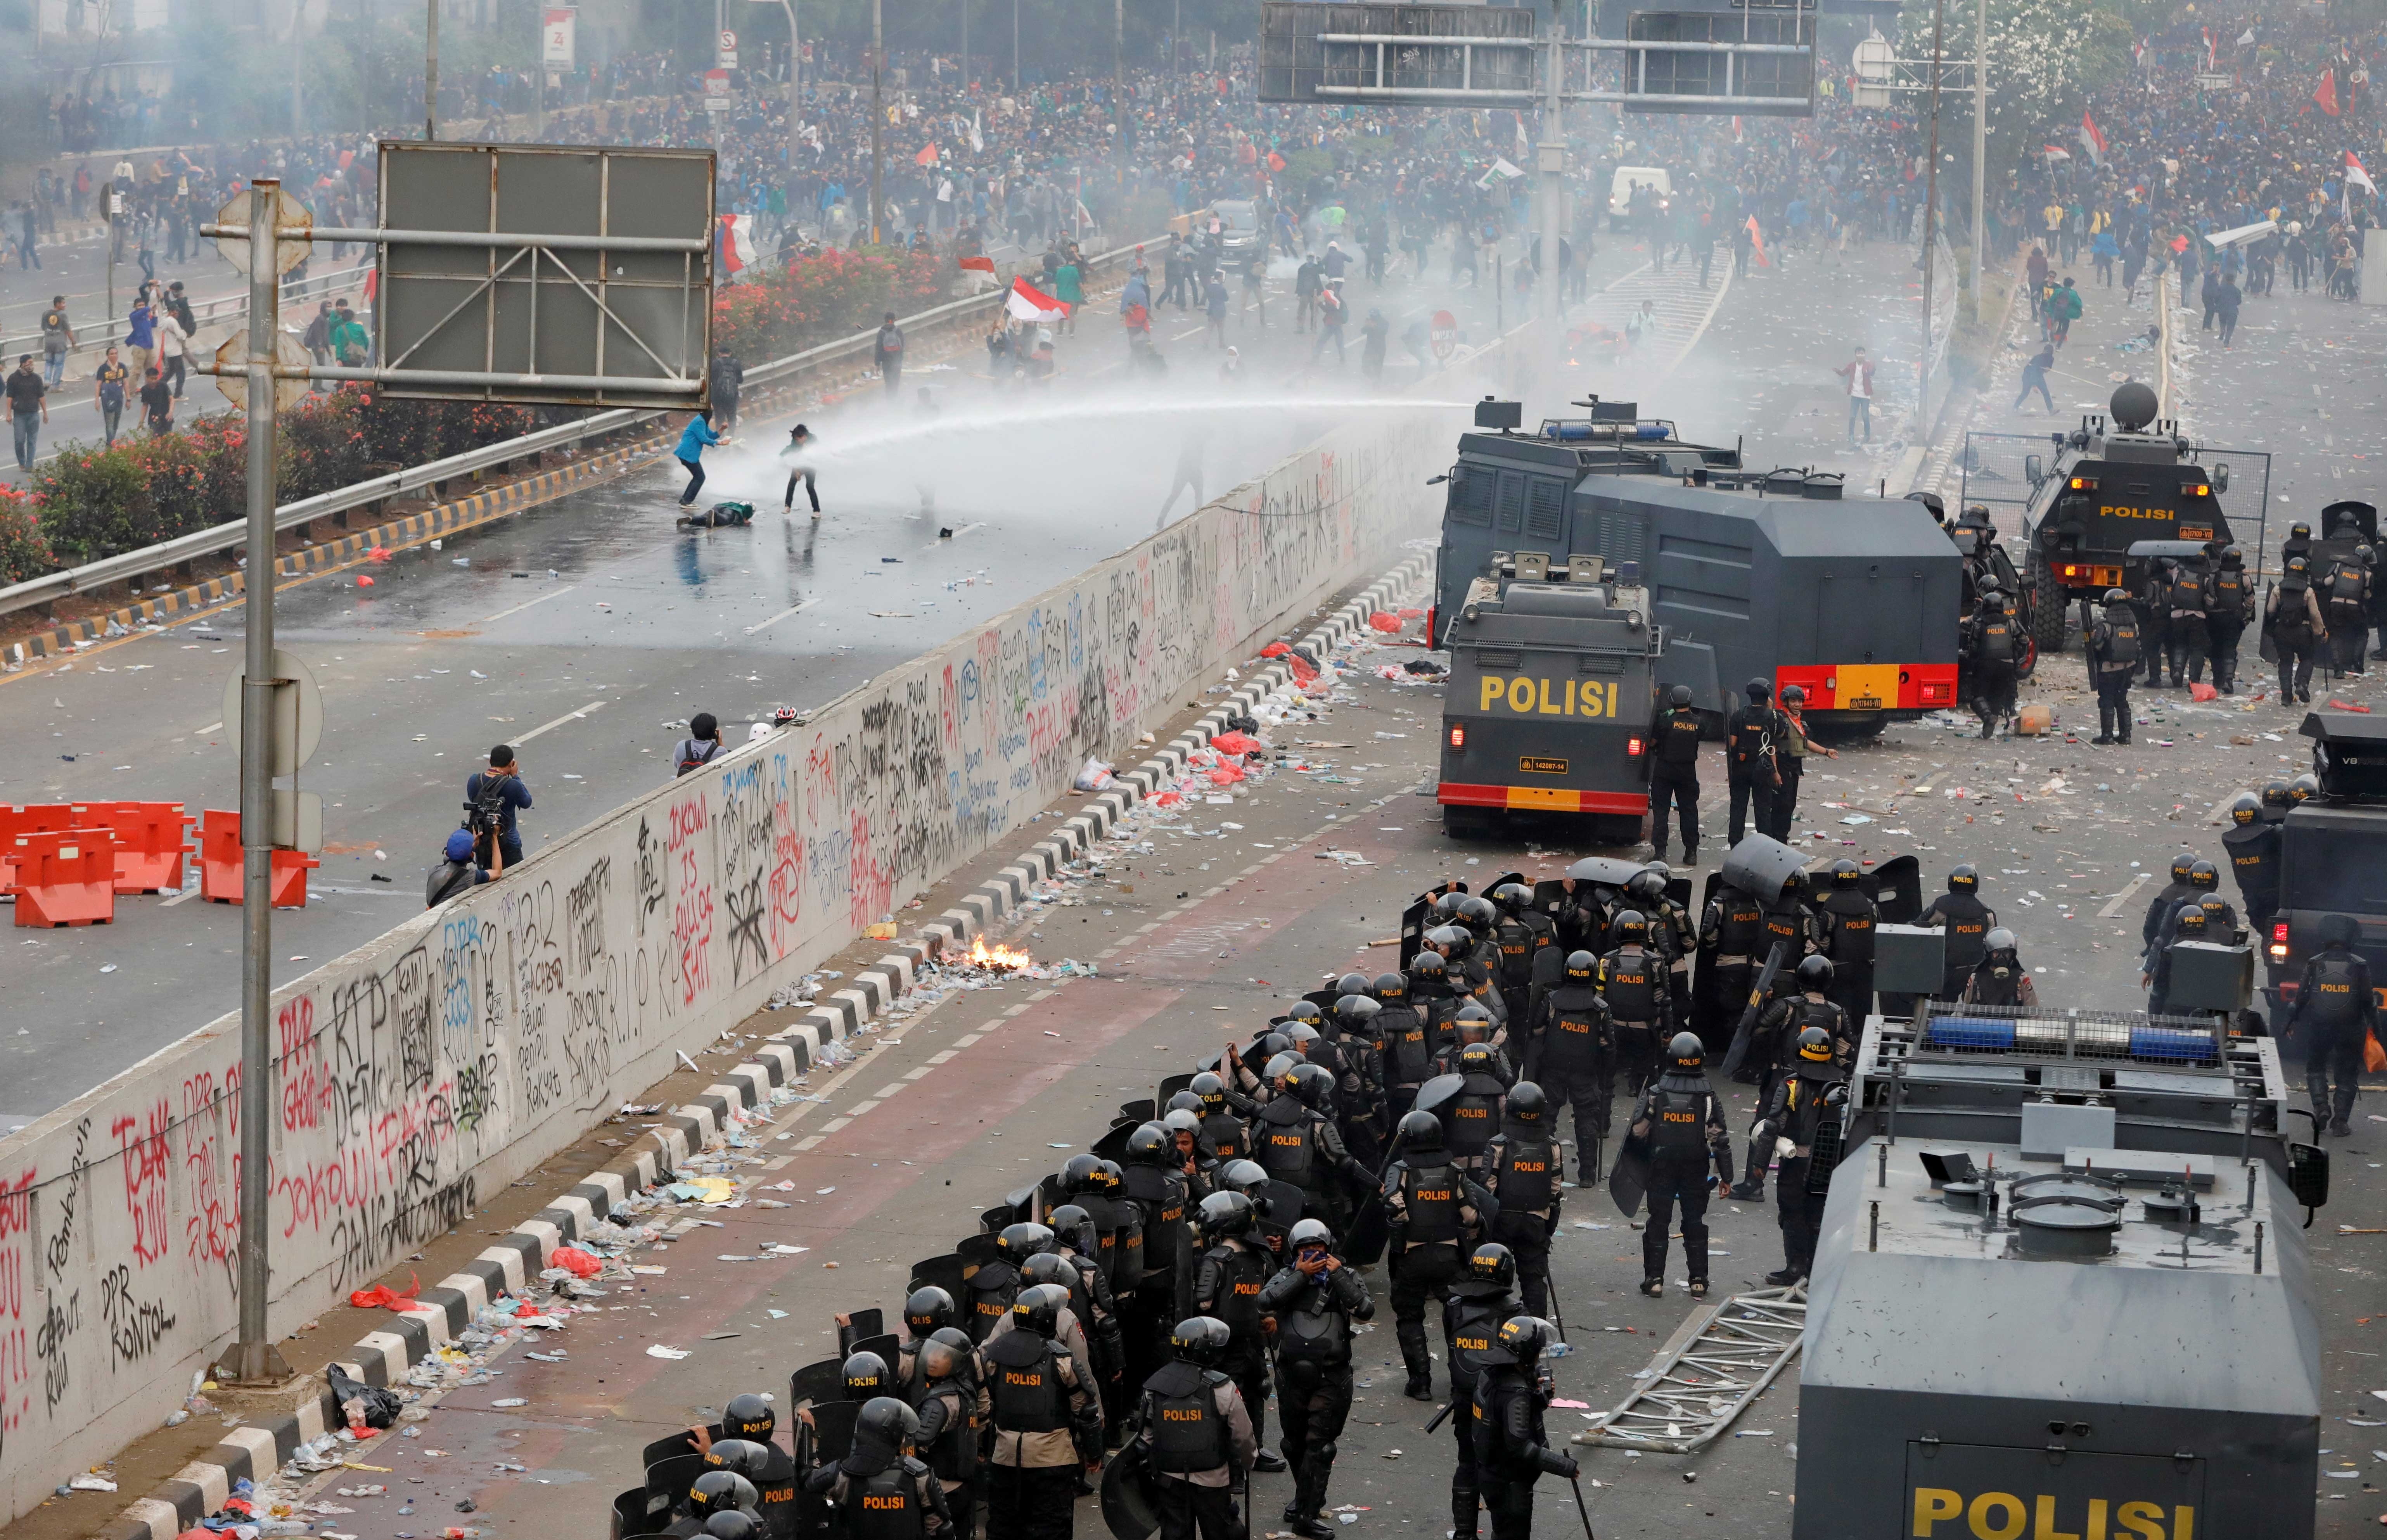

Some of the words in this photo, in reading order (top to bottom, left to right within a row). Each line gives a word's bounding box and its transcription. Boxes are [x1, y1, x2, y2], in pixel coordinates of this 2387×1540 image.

[2100, 506, 2174, 520] POLISI
[2342, 572, 2359, 580] POLISI
[1047, 643, 1062, 683] DPR
[1480, 676, 1617, 717] POLISI
[1674, 722, 1695, 731] POLISI
[1535, 762, 1564, 770] 142087-14
[2236, 856, 2259, 865] POLISI
[1953, 876, 1973, 884] POLISI
[1733, 913, 1758, 921] POLISI
[1768, 922, 1794, 936] POLISI
[1846, 920, 1869, 929] POLISI
[1957, 925, 1981, 933] POLISI
[1536, 937, 1548, 946] LISI
[1616, 975, 1643, 984] POLISI
[2321, 984, 2349, 993] POLISI
[1440, 1021, 1453, 1031] POL
[1560, 1021, 1588, 1034] POLISI
[1406, 1031, 1424, 1042] POLISI
[1806, 1044, 1828, 1052] POLISI
[1286, 1073, 1299, 1084] OLISI
[184, 1071, 215, 1156] DPR
[1456, 1109, 1487, 1118] POLISI
[1664, 1113, 1695, 1123] POLISI
[1272, 1136, 1301, 1146] POLISI
[1217, 1146, 1233, 1155] LISI
[1515, 1162, 1544, 1171] POLISI
[1105, 1178, 1119, 1187] LISI
[1418, 1191, 1449, 1200] POLISI
[1162, 1207, 1182, 1221] POLISI
[1473, 1256, 1497, 1267] POLISI
[102, 1263, 135, 1321] DPR
[1235, 1283, 1259, 1295] POLISI
[977, 1302, 1005, 1316] POLISI
[1012, 1304, 1029, 1315] OLISI
[912, 1316, 931, 1325] OLIS
[1457, 1337, 1487, 1350] POLISI
[849, 1376, 877, 1386] POLISI
[1006, 1372, 1041, 1385] POLISI
[1164, 1409, 1201, 1421] POLISI
[743, 1419, 771, 1433] POLISI
[765, 1488, 793, 1503] POLISI
[864, 1497, 904, 1509] POLISI
[1913, 1487, 2194, 1540] POLISI
